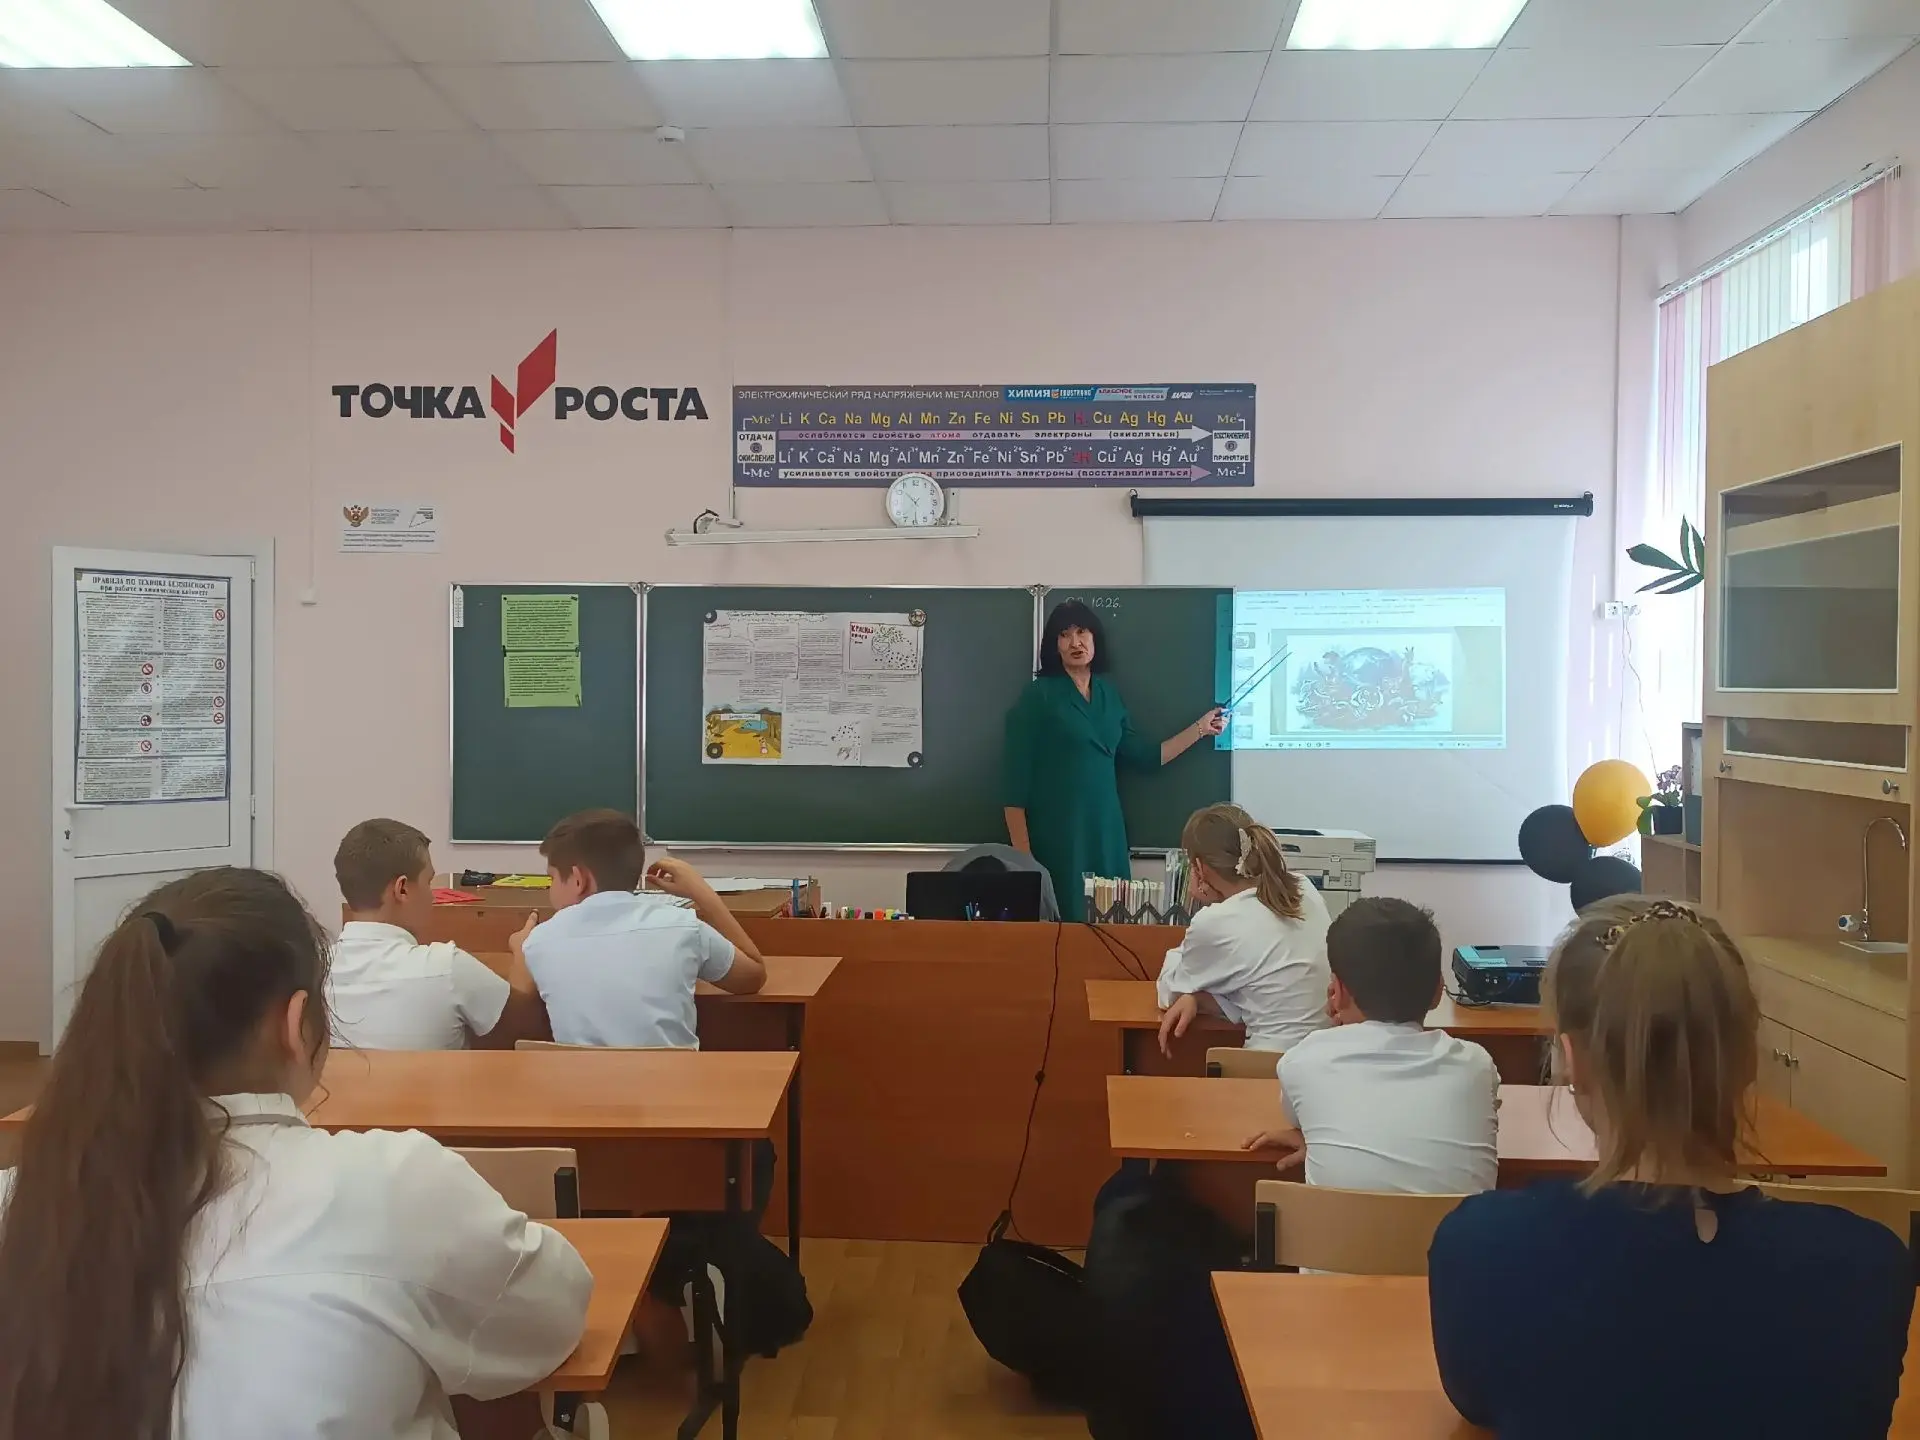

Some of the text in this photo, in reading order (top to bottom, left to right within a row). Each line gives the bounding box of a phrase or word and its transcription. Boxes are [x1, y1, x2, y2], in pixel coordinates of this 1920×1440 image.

[738, 390, 849, 400] ЭЛЕКТРОХИМИЧЕСКИЙ
[851, 390, 872, 400] РЯД
[945, 390, 1000, 400] МЕТАЛЛОВ
[1008, 389, 1051, 398] ХИМИЯ
[332, 383, 709, 421] ТОЧКА РОСТА
[780, 412, 792, 425] Li
[800, 412, 811, 425] K
[818, 412, 837, 425] Ca
[845, 412, 863, 425] Na
[871, 412, 891, 428] Mg
[898, 412, 913, 425] Al
[921, 412, 941, 425] Mn
[948, 412, 967, 425] Zn
[974, 412, 991, 425] Fe
[999, 412, 1013, 424] Ni
[1021, 412, 1040, 424] Sn
[1047, 412, 1066, 424] Pb
[1093, 411, 1112, 424] Cu
[1120, 411, 1139, 427] Ag
[1147, 411, 1166, 427] Hg
[1174, 411, 1193, 424] Au
[739, 433, 774, 442] ОТДАЧА
[872, 431, 922, 439] свойство
[972, 432, 1021, 440] отдавать
[1035, 431, 1092, 439] электроны
[1109, 431, 1180, 439] (окисляться)
[783, 470, 851, 478] усиливается
[854, 469, 904, 478] свойство
[936, 470, 1012, 478] присоединять
[1016, 470, 1074, 478] электроны
[1077, 469, 1193, 478] (восстанавливаться)
[125, 578, 136, 586] ПО
